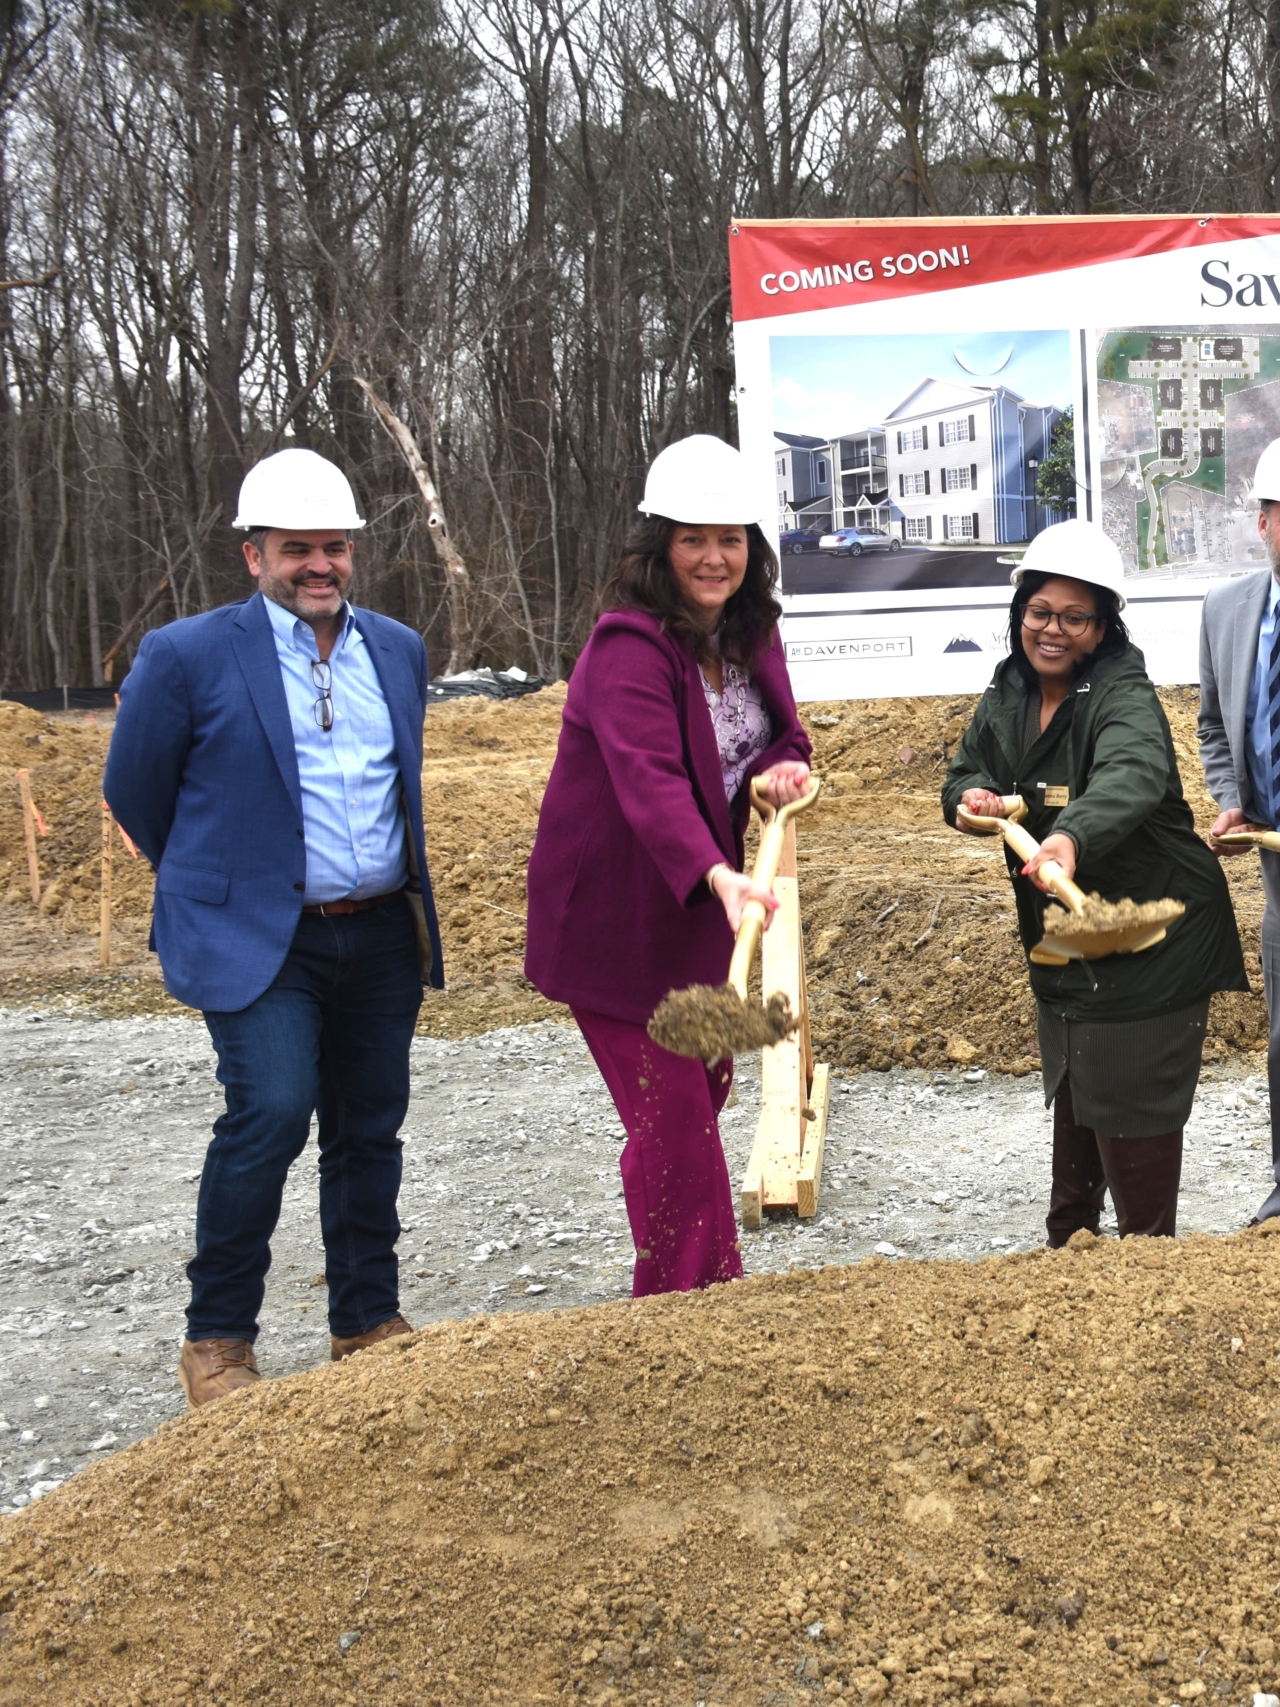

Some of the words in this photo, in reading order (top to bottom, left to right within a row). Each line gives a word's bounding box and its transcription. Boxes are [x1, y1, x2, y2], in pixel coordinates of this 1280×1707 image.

[760, 259, 874, 296] COMING
[881, 244, 971, 280] SOON!
[803, 642, 906, 656] DAVENPORT
